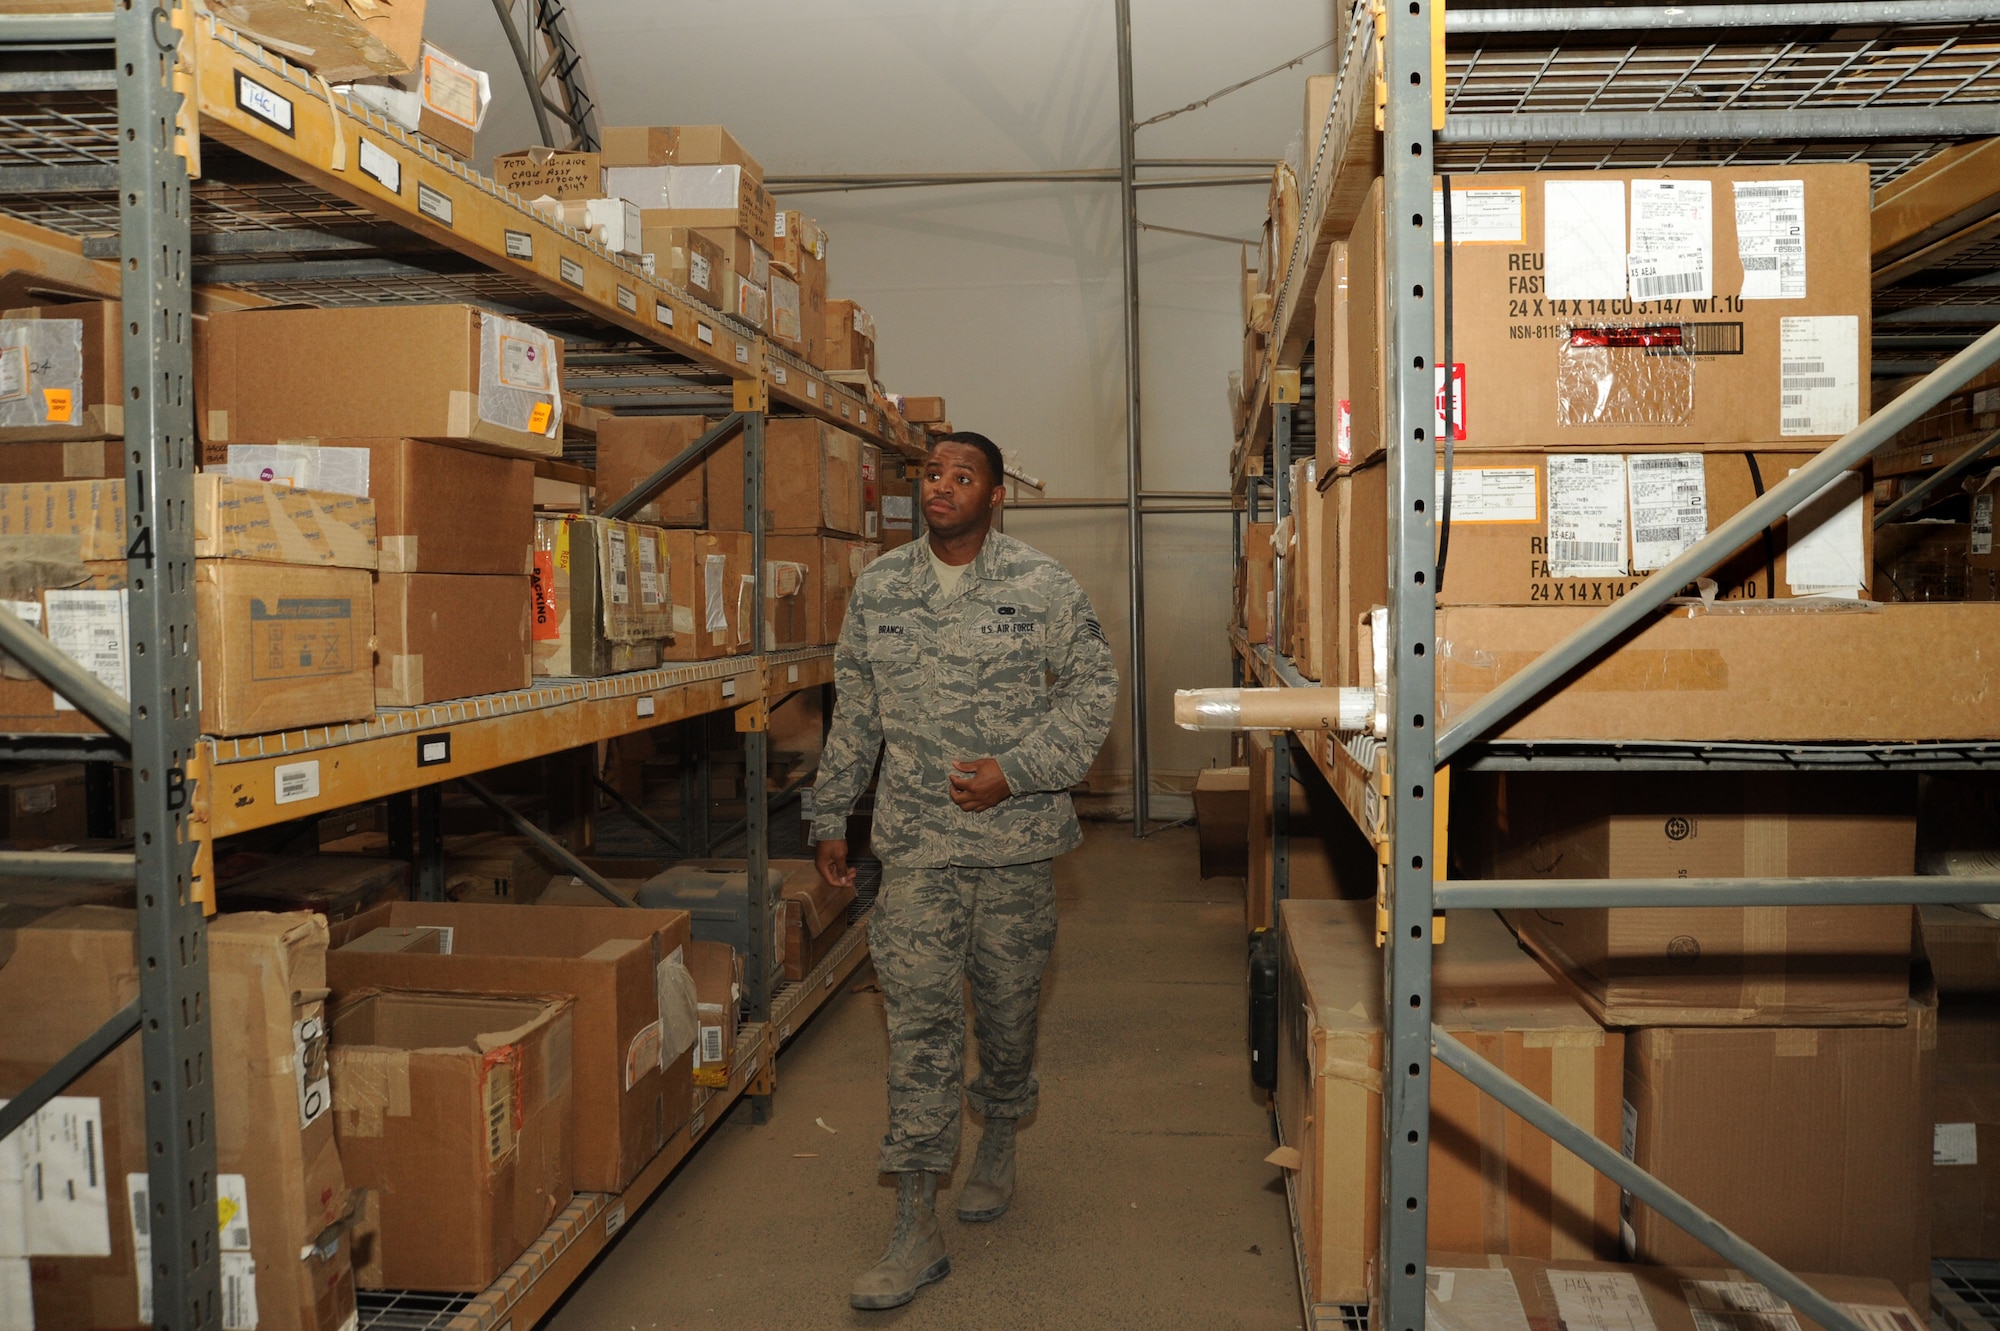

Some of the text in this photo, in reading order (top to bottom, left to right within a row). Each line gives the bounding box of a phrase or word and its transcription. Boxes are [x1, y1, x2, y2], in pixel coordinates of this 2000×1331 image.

[151, 7, 175, 52] C
[1790, 226, 1800, 235] 2
[1509, 253, 1544, 271] REU
[1509, 302, 1528, 317] 24
[1533, 300, 1544, 317] X
[1549, 301, 1567, 316] 14
[1572, 301, 1583, 316] X
[1590, 300, 1607, 315] 14
[1691, 496, 1701, 506] 2
[531, 567, 547, 624] PACKING
[1531, 583, 1549, 600] 24
[1554, 583, 1564, 600] X
[1569, 582, 1587, 600] 14
[1592, 582, 1602, 600] X
[878, 625, 904, 635] BRANCH
[981, 623, 1035, 634] U.S. AIR FORCE
[166, 768, 187, 811] B
